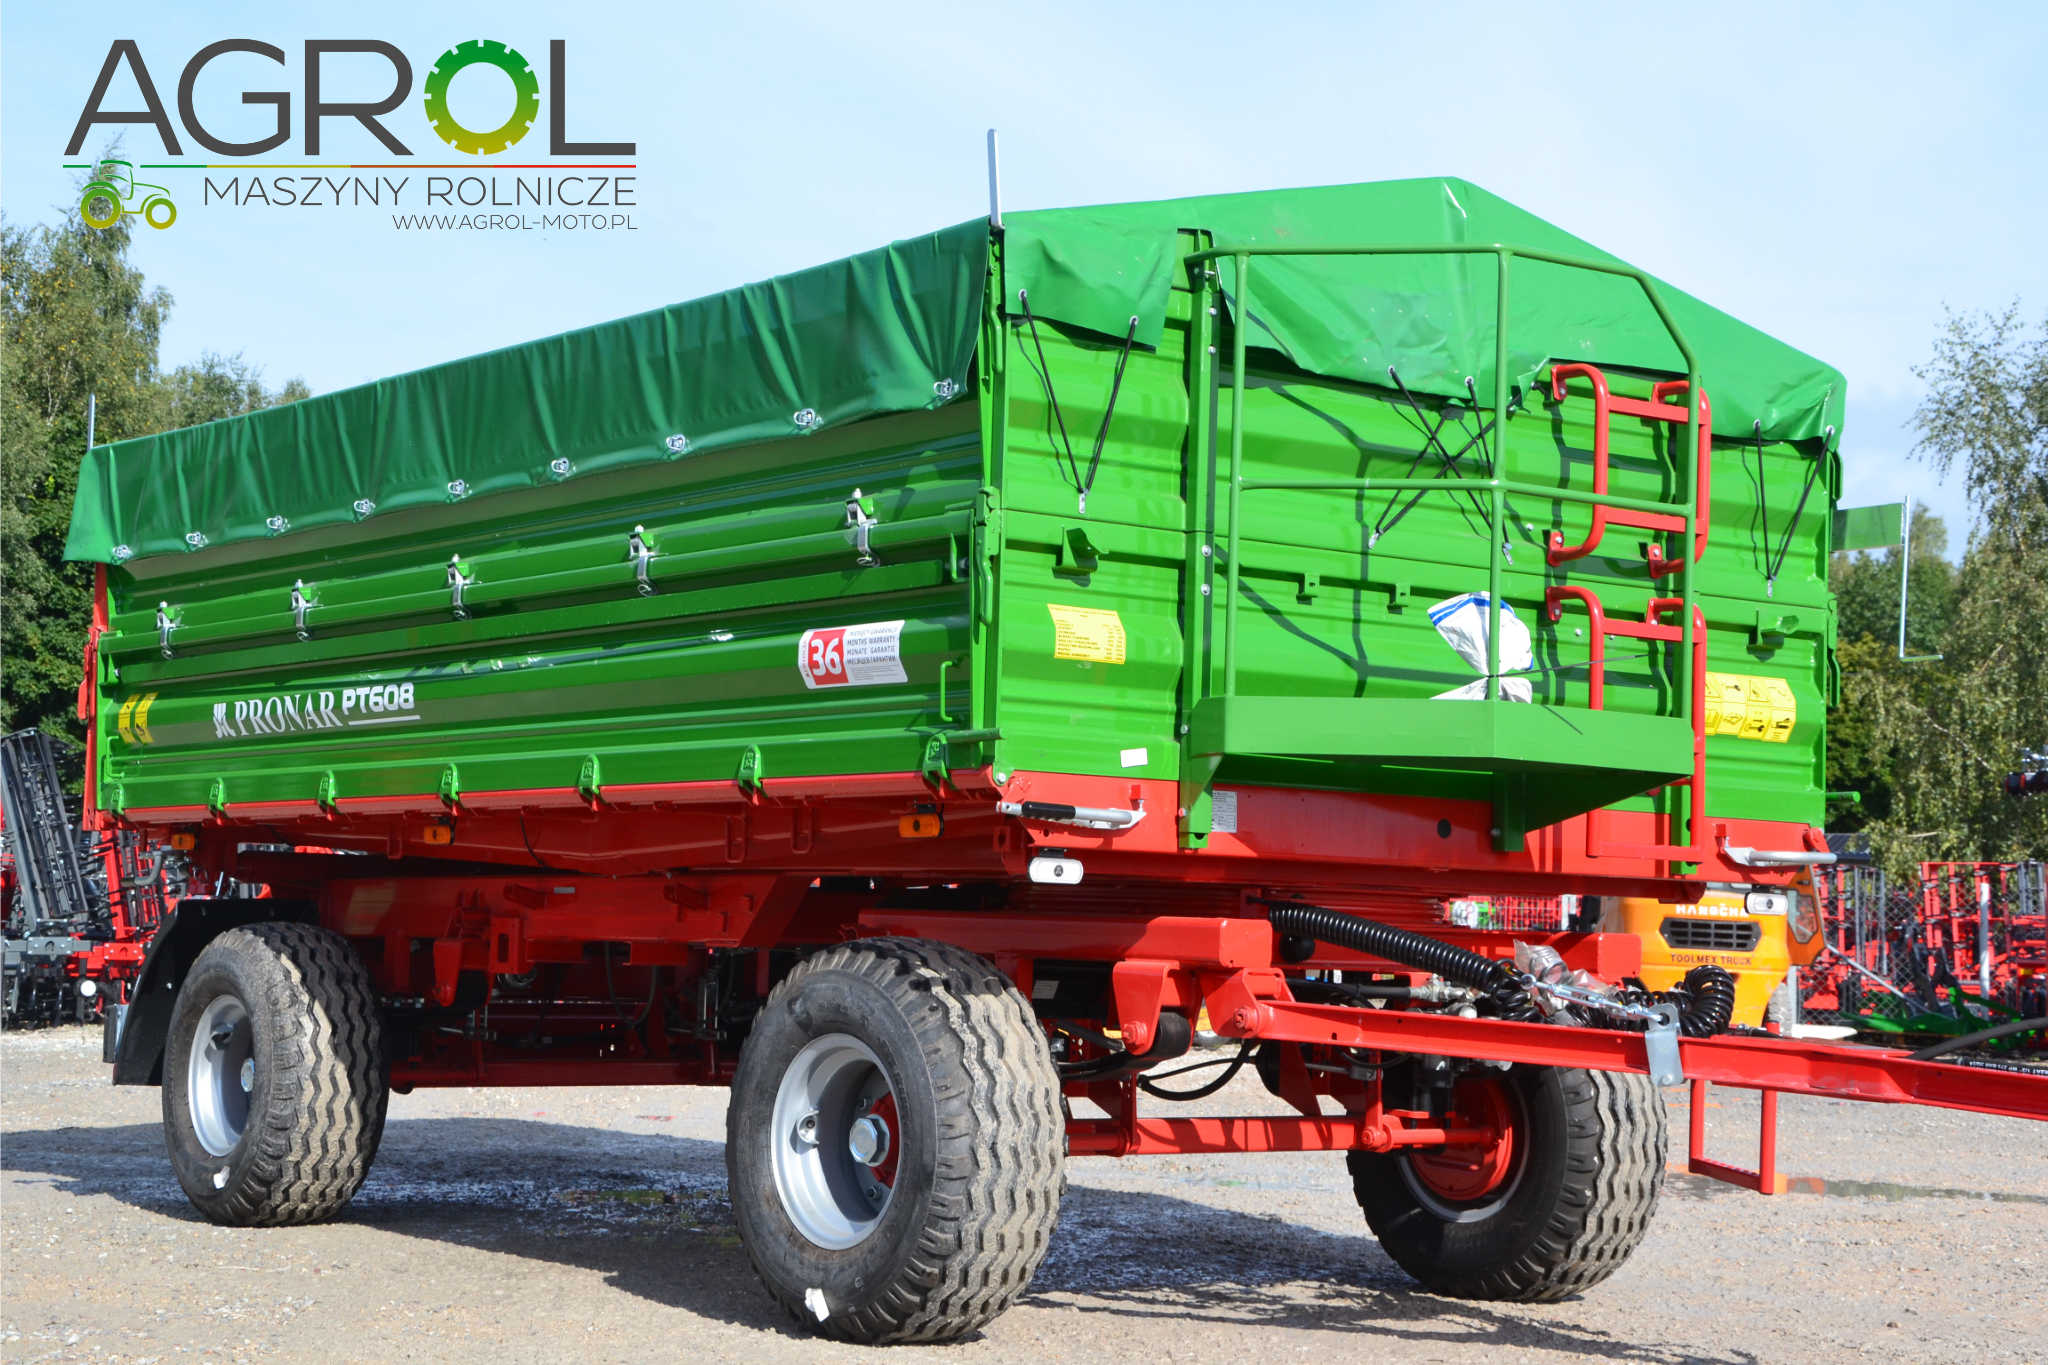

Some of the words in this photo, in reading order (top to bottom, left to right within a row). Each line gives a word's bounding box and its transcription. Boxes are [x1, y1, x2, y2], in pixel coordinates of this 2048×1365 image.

[847, 637, 867, 647] MONTHS
[868, 636, 896, 645] WARRANTY
[810, 637, 843, 677] 36
[846, 648, 867, 656] MONATE
[870, 646, 895, 654] GARANTIE
[234, 691, 343, 736] PRONAR
[342, 682, 415, 716] PT608
[1671, 954, 1717, 964] TOOLMEX
[1720, 956, 1752, 966] TRUCK
